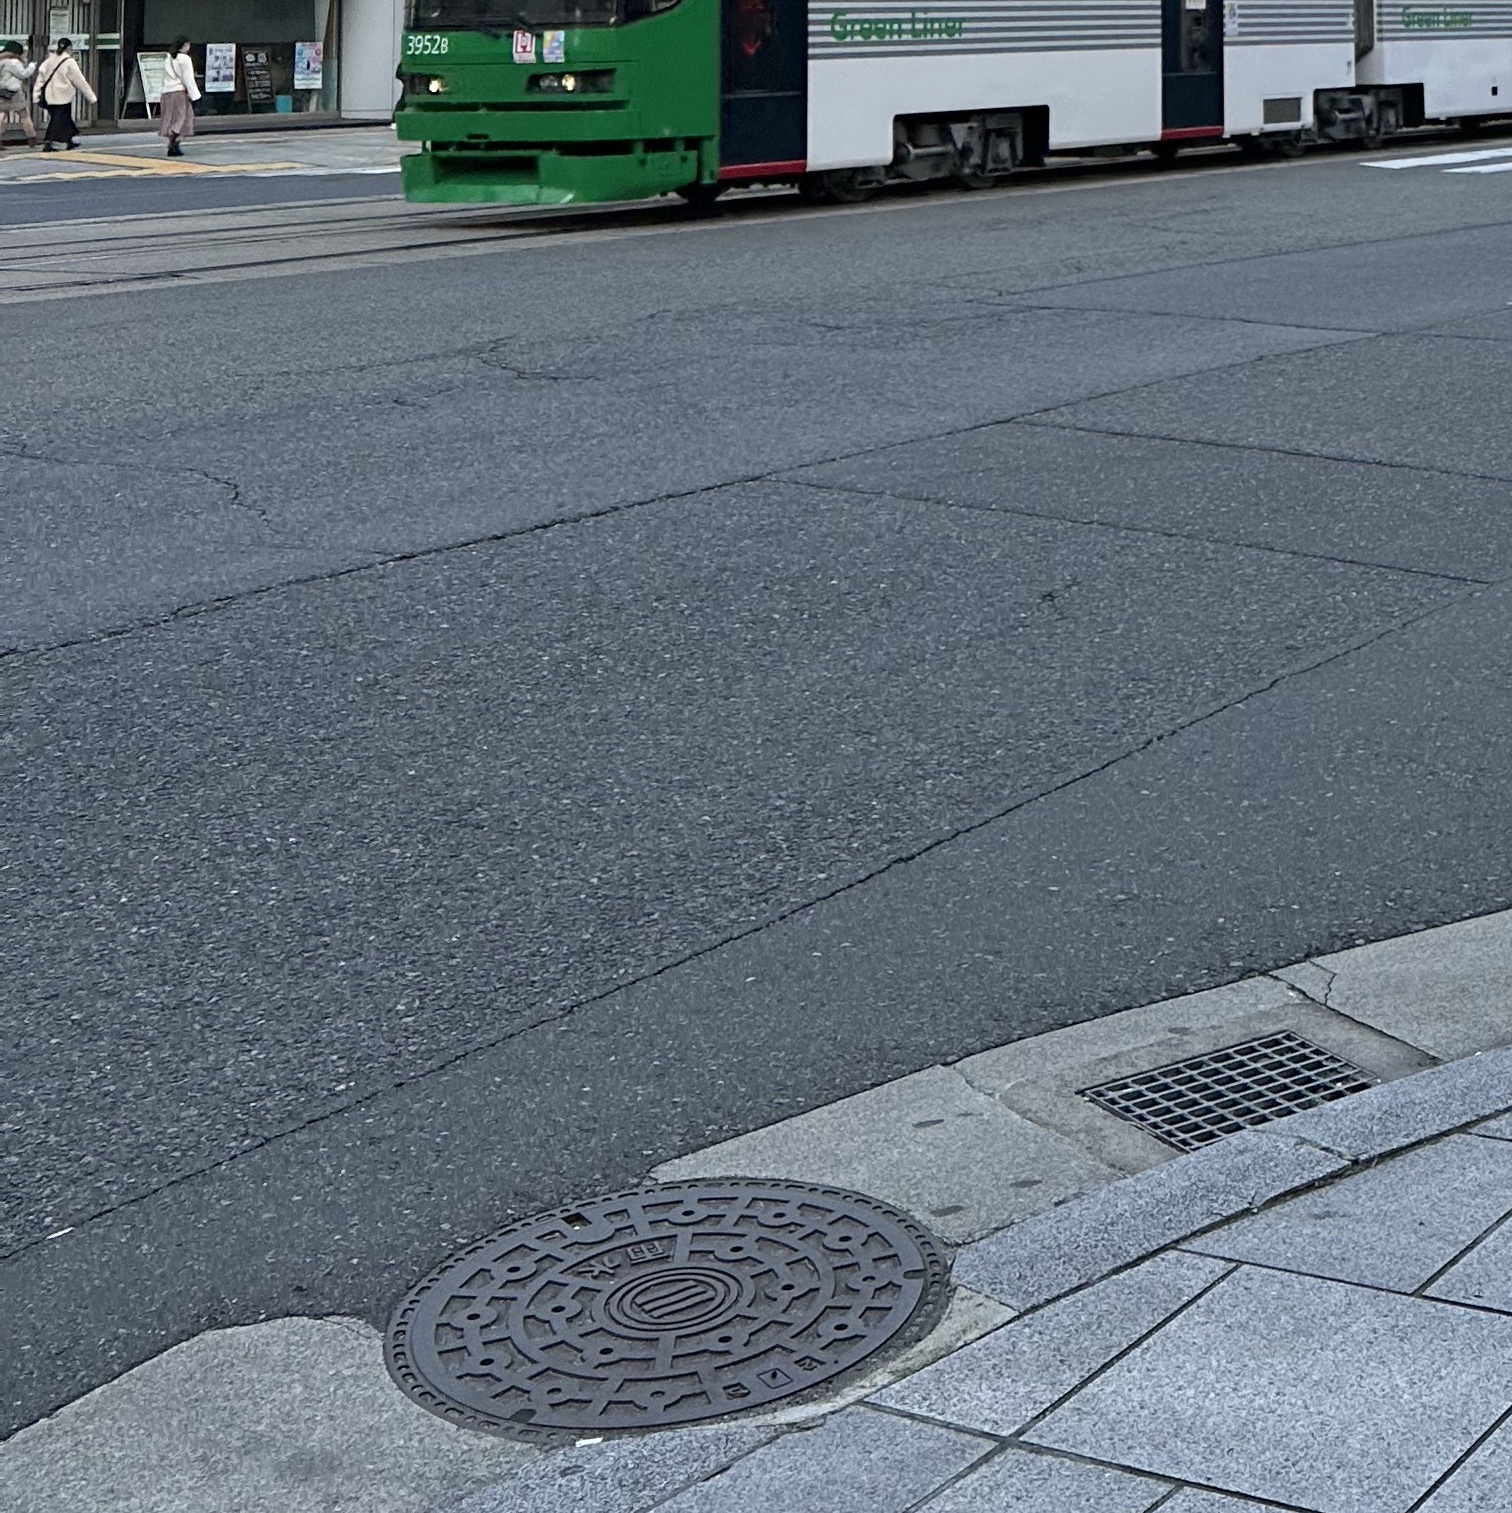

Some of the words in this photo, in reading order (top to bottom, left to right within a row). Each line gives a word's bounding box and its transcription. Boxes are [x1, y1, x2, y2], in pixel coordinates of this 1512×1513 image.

[829, 10, 902, 42] Green
[910, 11, 965, 39] Liner
[406, 34, 449, 56] 3952B
